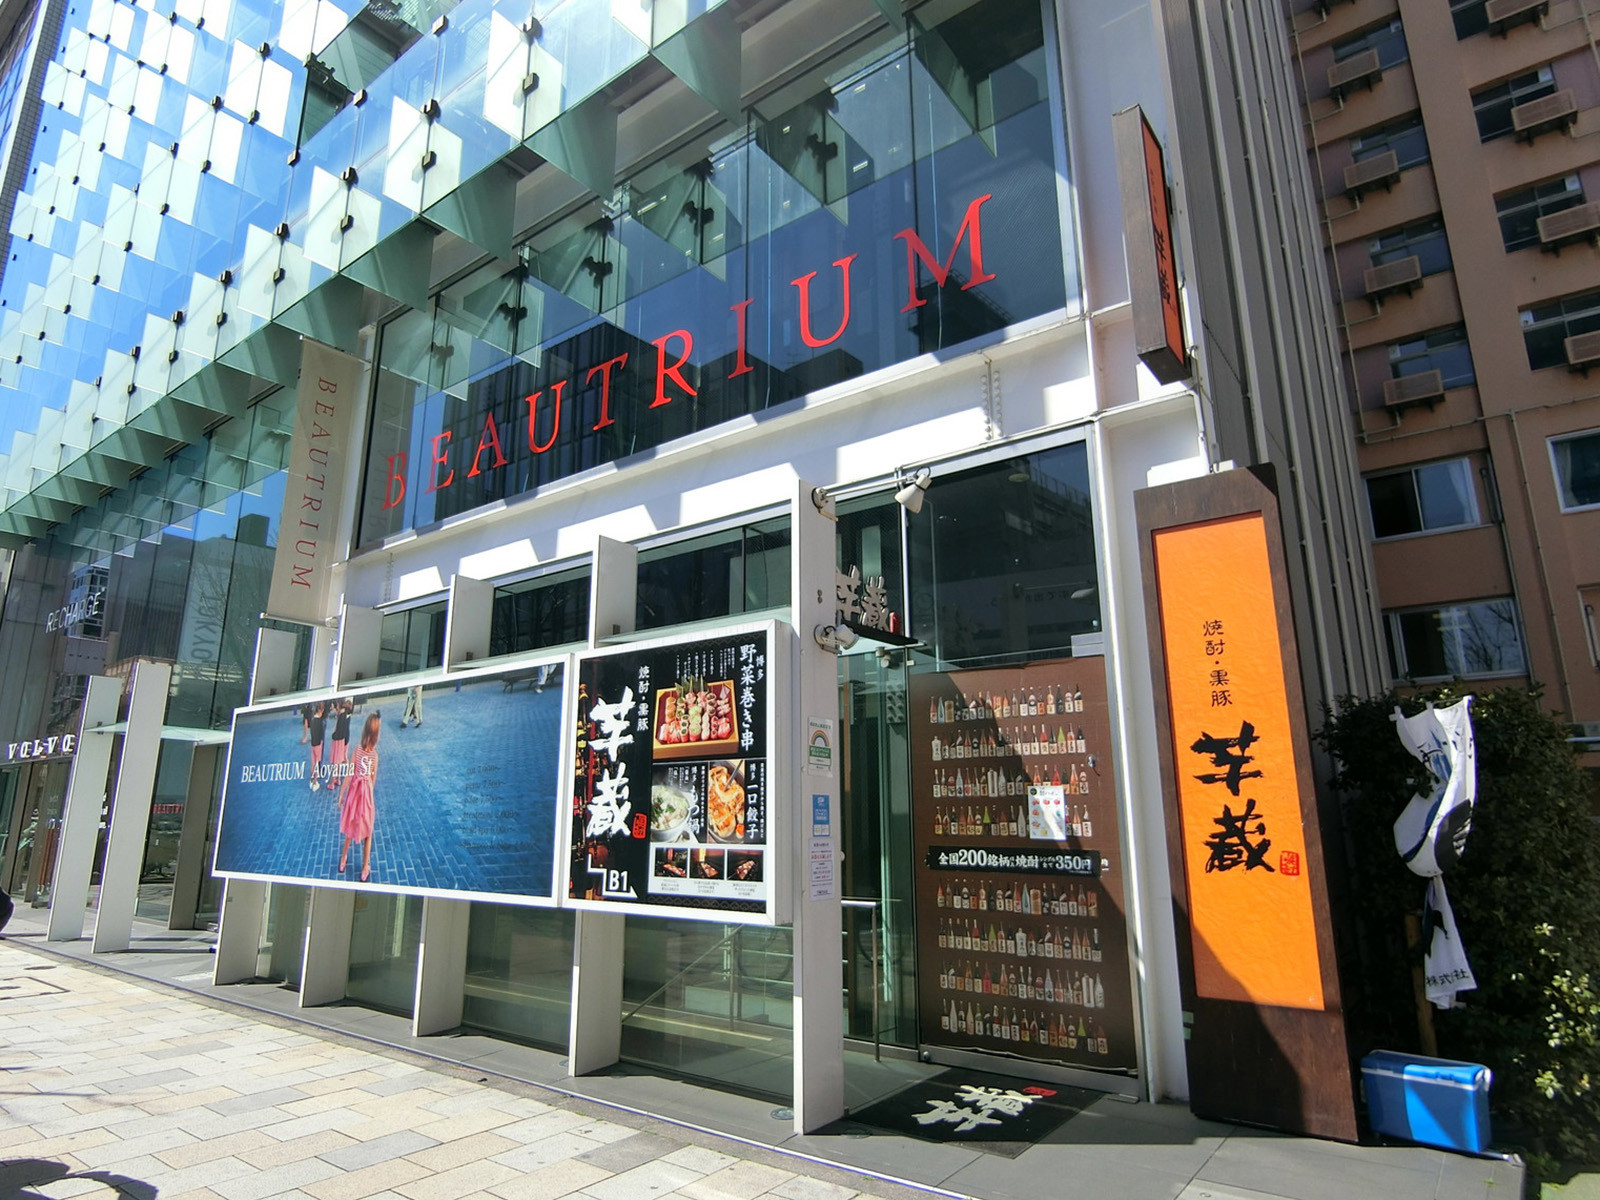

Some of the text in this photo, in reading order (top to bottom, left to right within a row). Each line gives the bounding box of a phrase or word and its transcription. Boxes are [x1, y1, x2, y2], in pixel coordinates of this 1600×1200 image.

[382, 193, 997, 511] BEAUTRIUM
[291, 376, 337, 589] BEAUTRIUM
[45, 591, 101, 633] RECHARGE
[756, 655, 765, 681] 博多
[1202, 619, 1233, 707] 焼酎・黒豚
[636, 665, 650, 732] 焼酎・黒豚
[740, 644, 757, 751] 野菜巻き串
[8, 734, 76, 760] VOLVO
[240, 756, 376, 783] BEAUTRIUM Aoyama St.
[746, 784, 759, 840] 一口餃子
[1190, 720, 1276, 875] 芋蔵
[608, 870, 629, 892] B1
